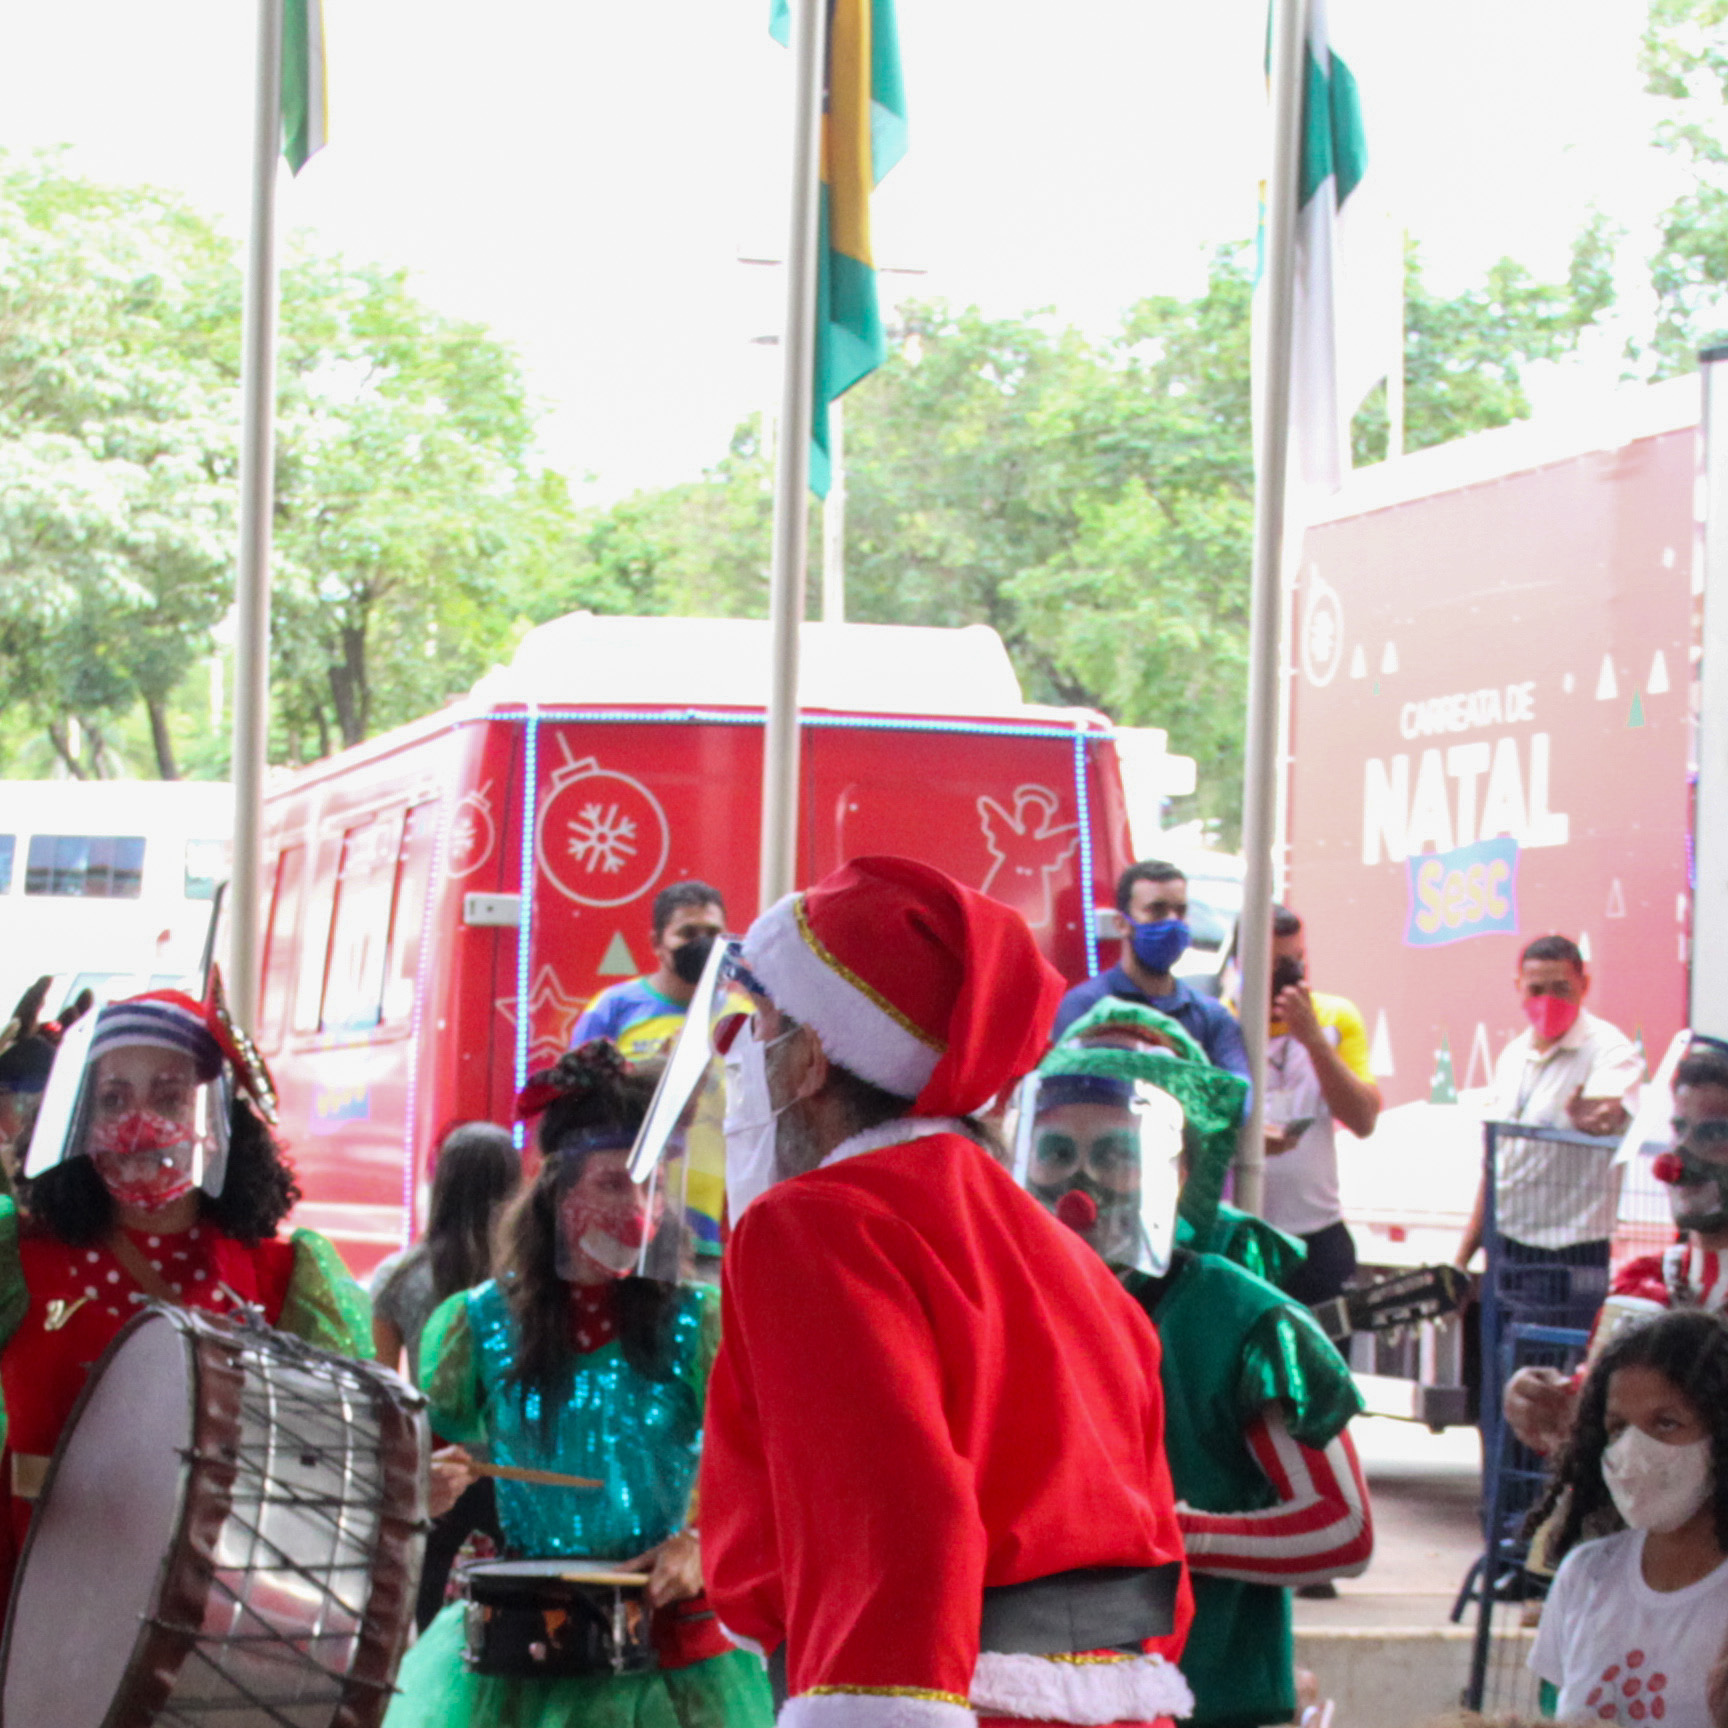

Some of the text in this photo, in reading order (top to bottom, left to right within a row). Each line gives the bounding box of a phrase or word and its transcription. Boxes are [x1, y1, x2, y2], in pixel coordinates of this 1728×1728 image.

[1507, 681, 1535, 722] DE
[1364, 733, 1569, 865] NATAL
[1416, 858, 1510, 932] Sesc
